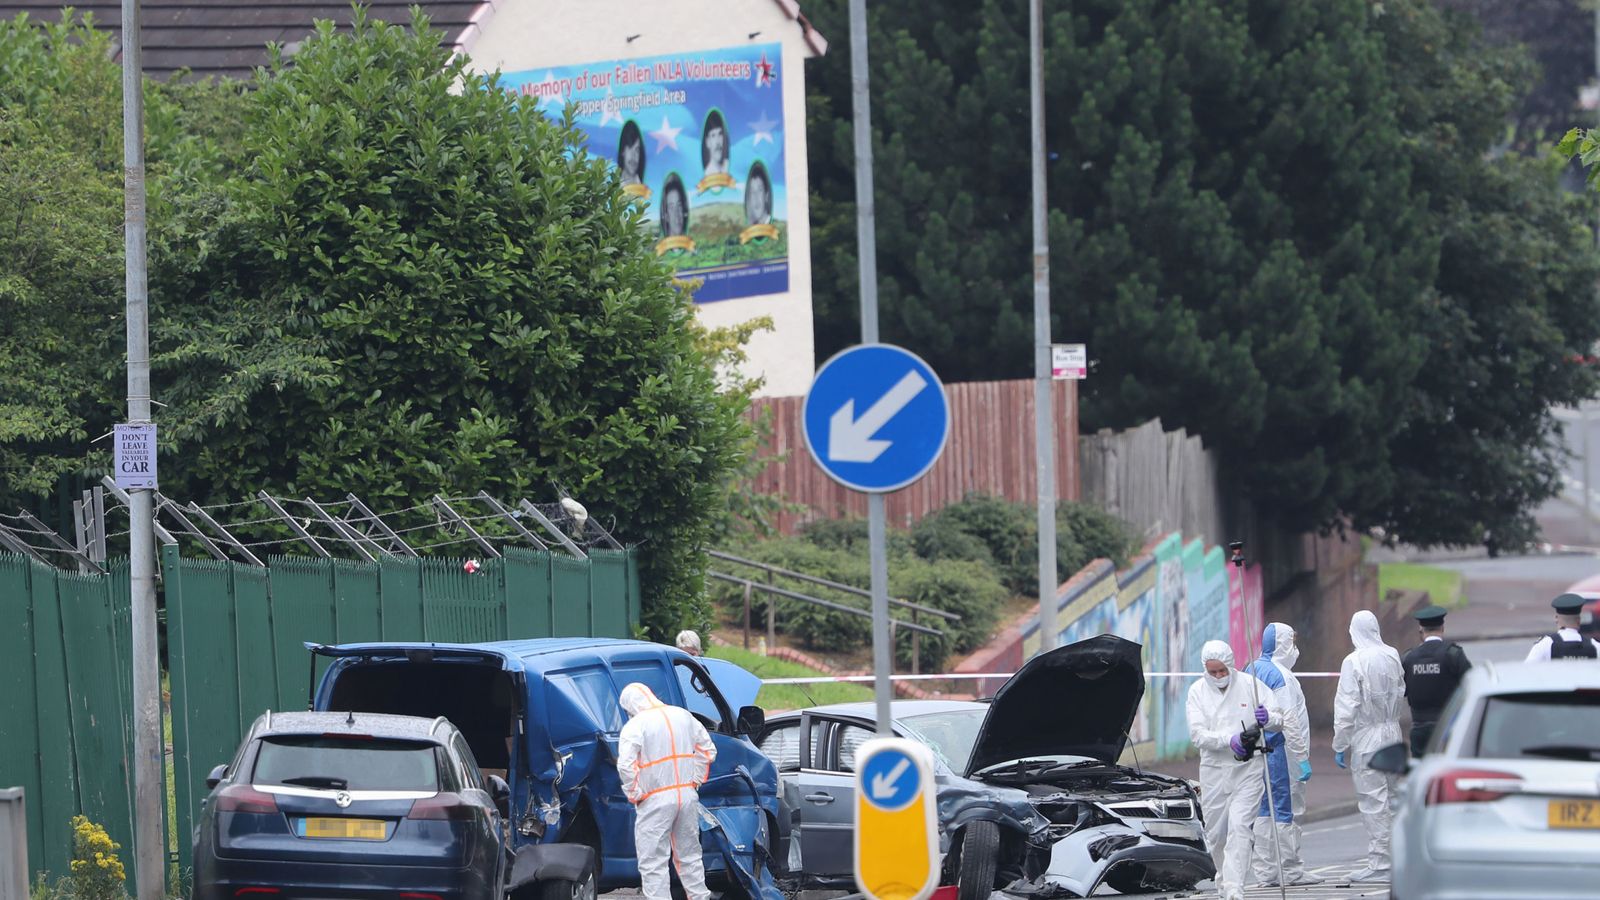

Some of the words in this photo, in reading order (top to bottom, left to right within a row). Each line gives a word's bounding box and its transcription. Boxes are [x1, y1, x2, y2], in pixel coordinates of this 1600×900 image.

[521, 78, 573, 97] Memory
[575, 70, 589, 91] of
[591, 72, 612, 88] our
[615, 64, 651, 85] Fallen
[654, 61, 683, 80] INLA
[686, 58, 751, 79] Volunteers
[607, 90, 661, 114] Springfield
[663, 89, 687, 105] Area
[122, 433, 147, 441] DON'T
[122, 461, 149, 473] CAR
[1413, 664, 1441, 675] POLICE
